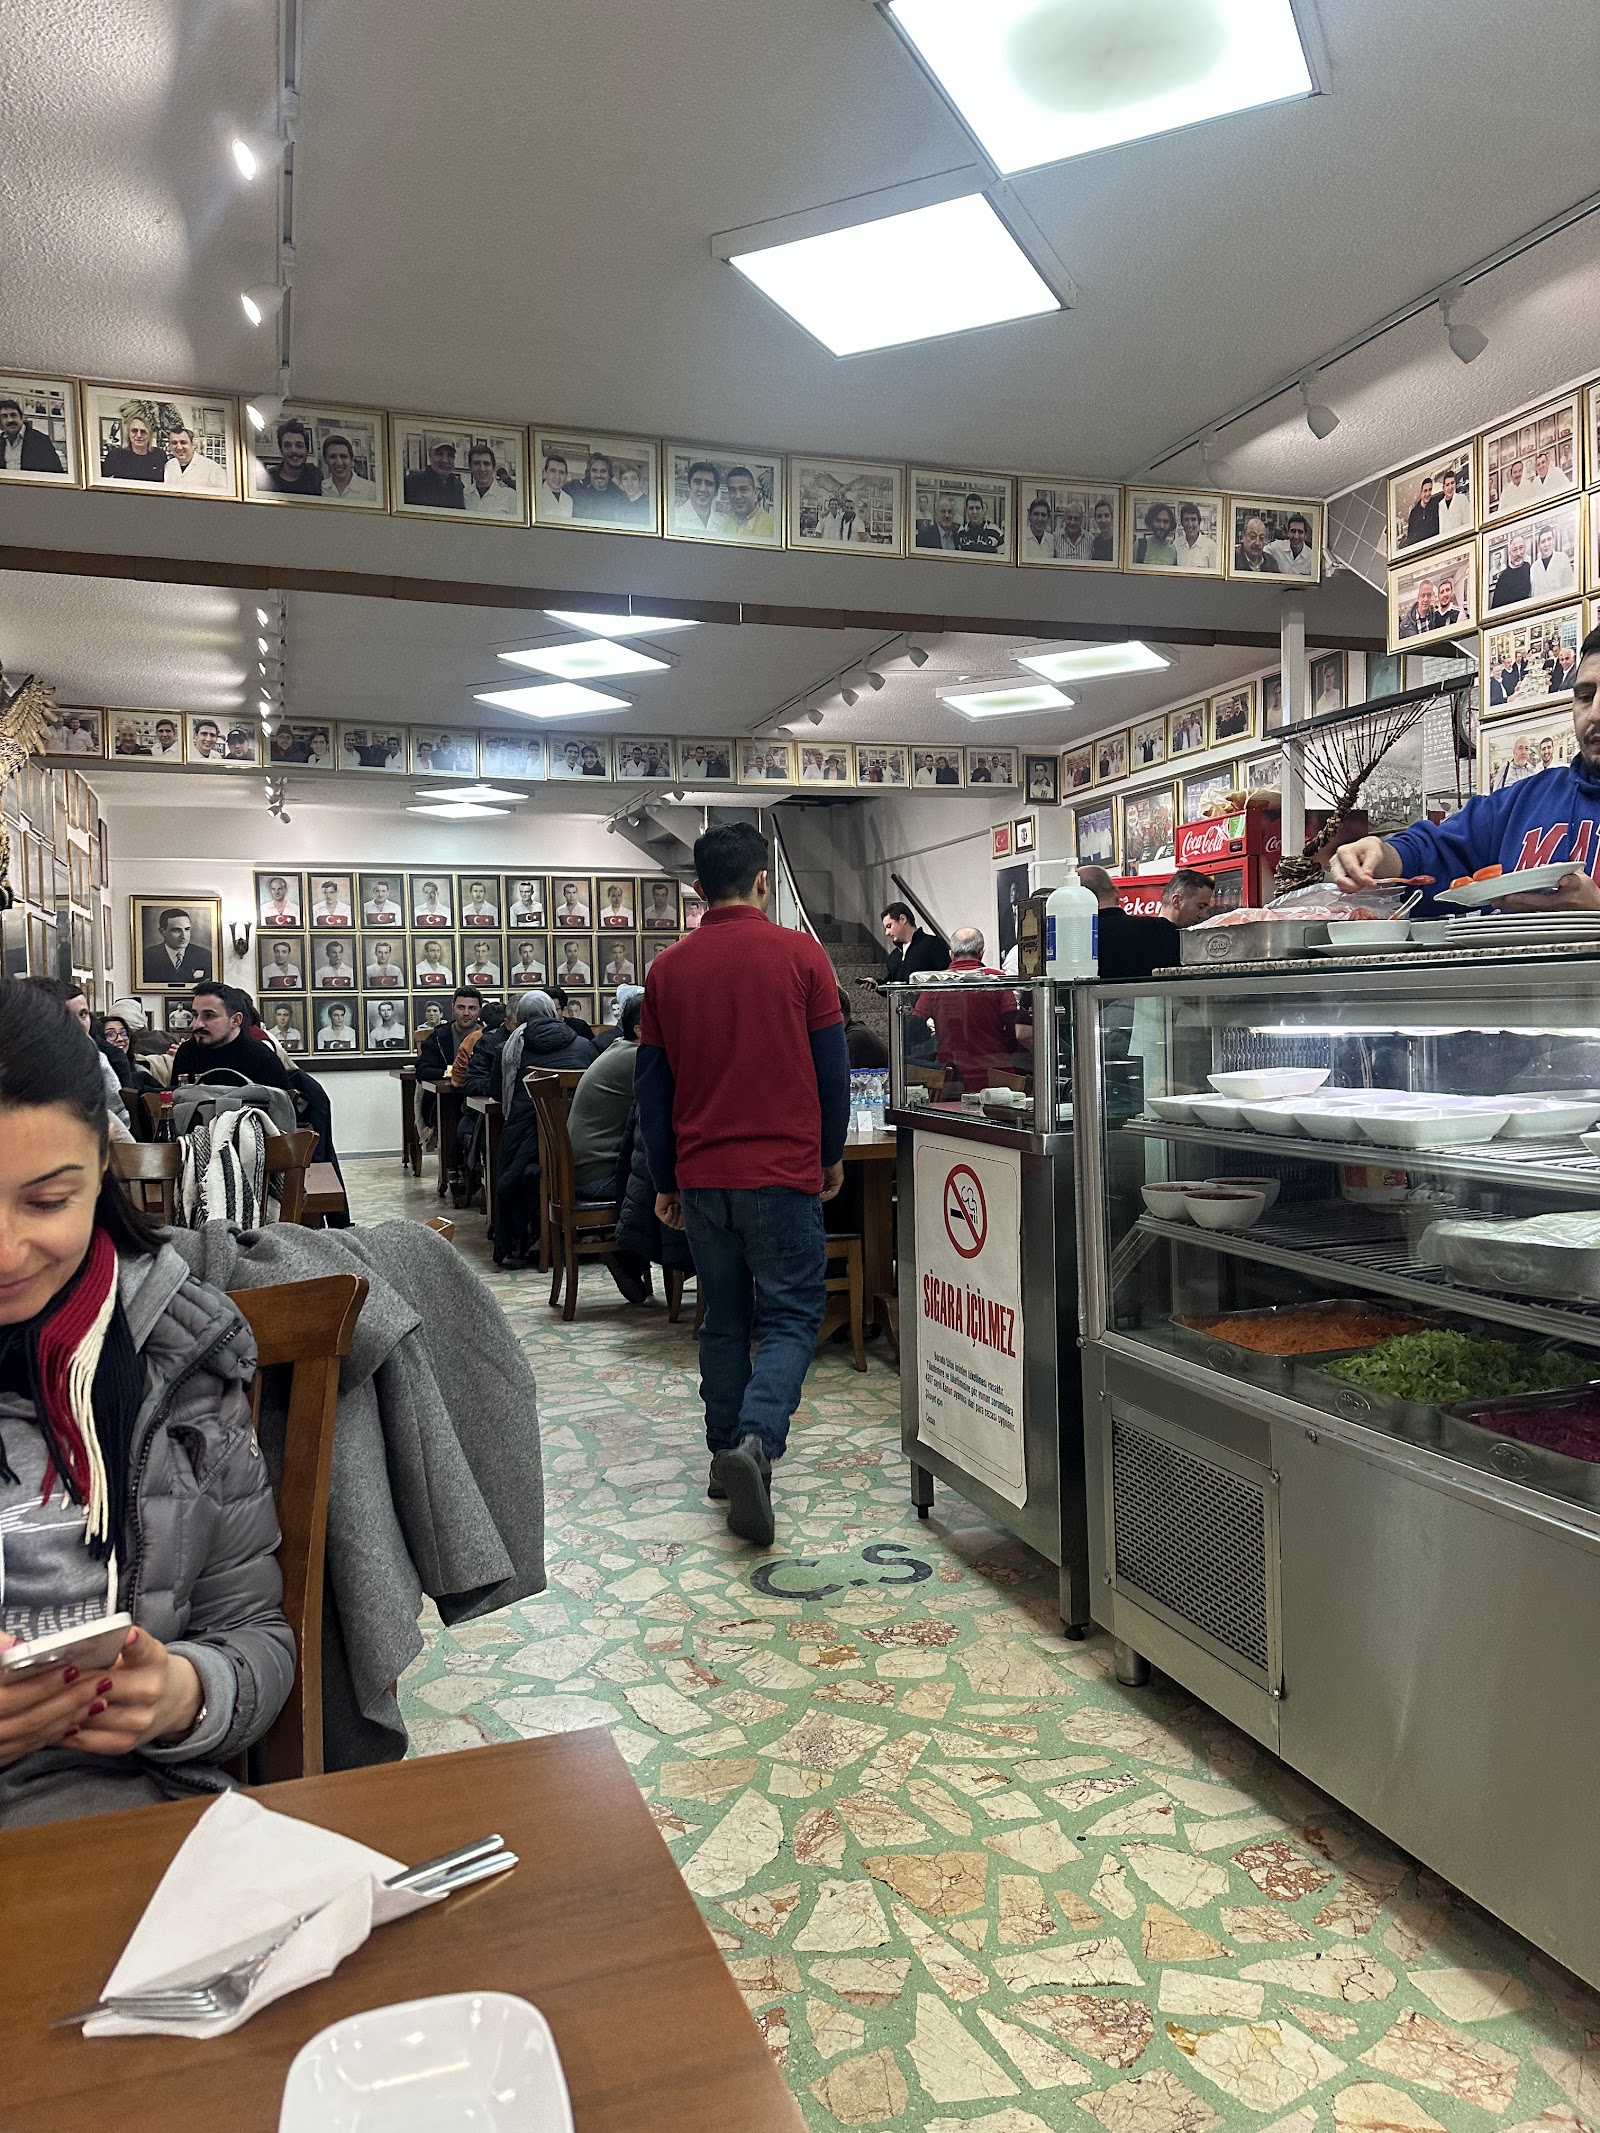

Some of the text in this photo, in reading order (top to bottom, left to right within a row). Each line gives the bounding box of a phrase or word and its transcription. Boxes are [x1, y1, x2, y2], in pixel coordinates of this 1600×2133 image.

[1182, 825, 1225, 857] Coca-Cola
[923, 1268, 1016, 1358] SİGARA İÇİLMEZ
